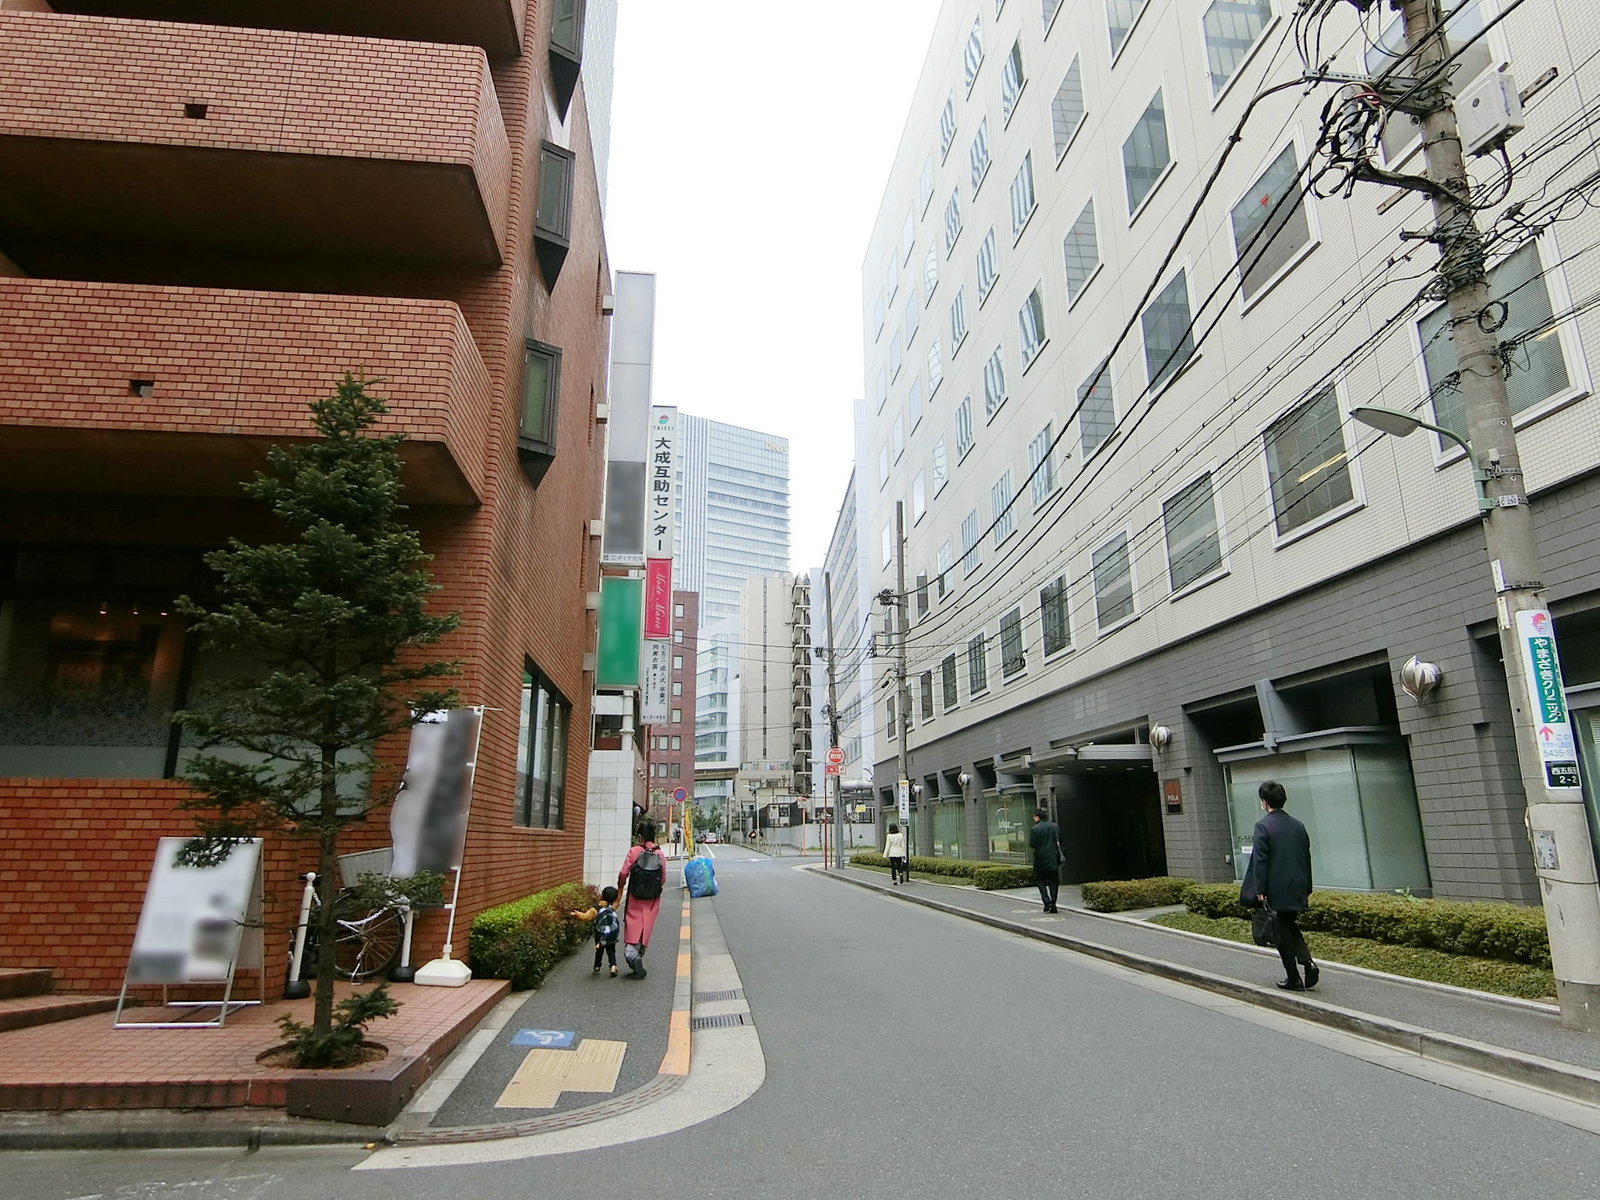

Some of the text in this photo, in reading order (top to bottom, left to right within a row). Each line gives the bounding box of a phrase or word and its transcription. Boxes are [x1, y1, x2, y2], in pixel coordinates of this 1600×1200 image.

[653, 436, 672, 551] 大成互助センター
